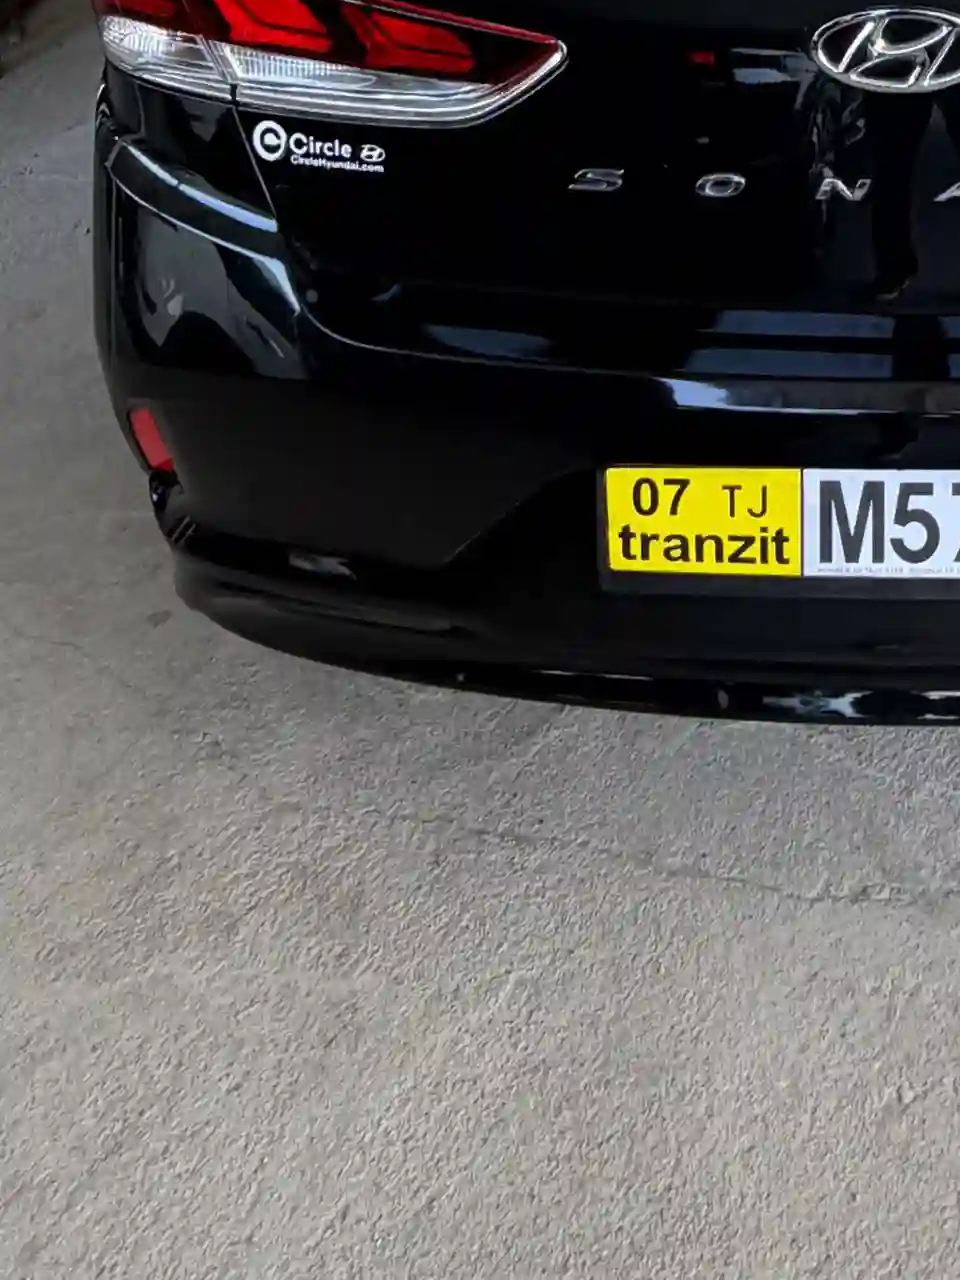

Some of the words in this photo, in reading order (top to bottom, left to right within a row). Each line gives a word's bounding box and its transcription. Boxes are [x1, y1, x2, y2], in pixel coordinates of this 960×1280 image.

[289, 132, 352, 158] Circle
[290, 154, 385, 173] CircleHyundai.com
[632, 477, 690, 516] 07
[721, 484, 768, 518] TJ
[618, 524, 790, 565] tranzit
